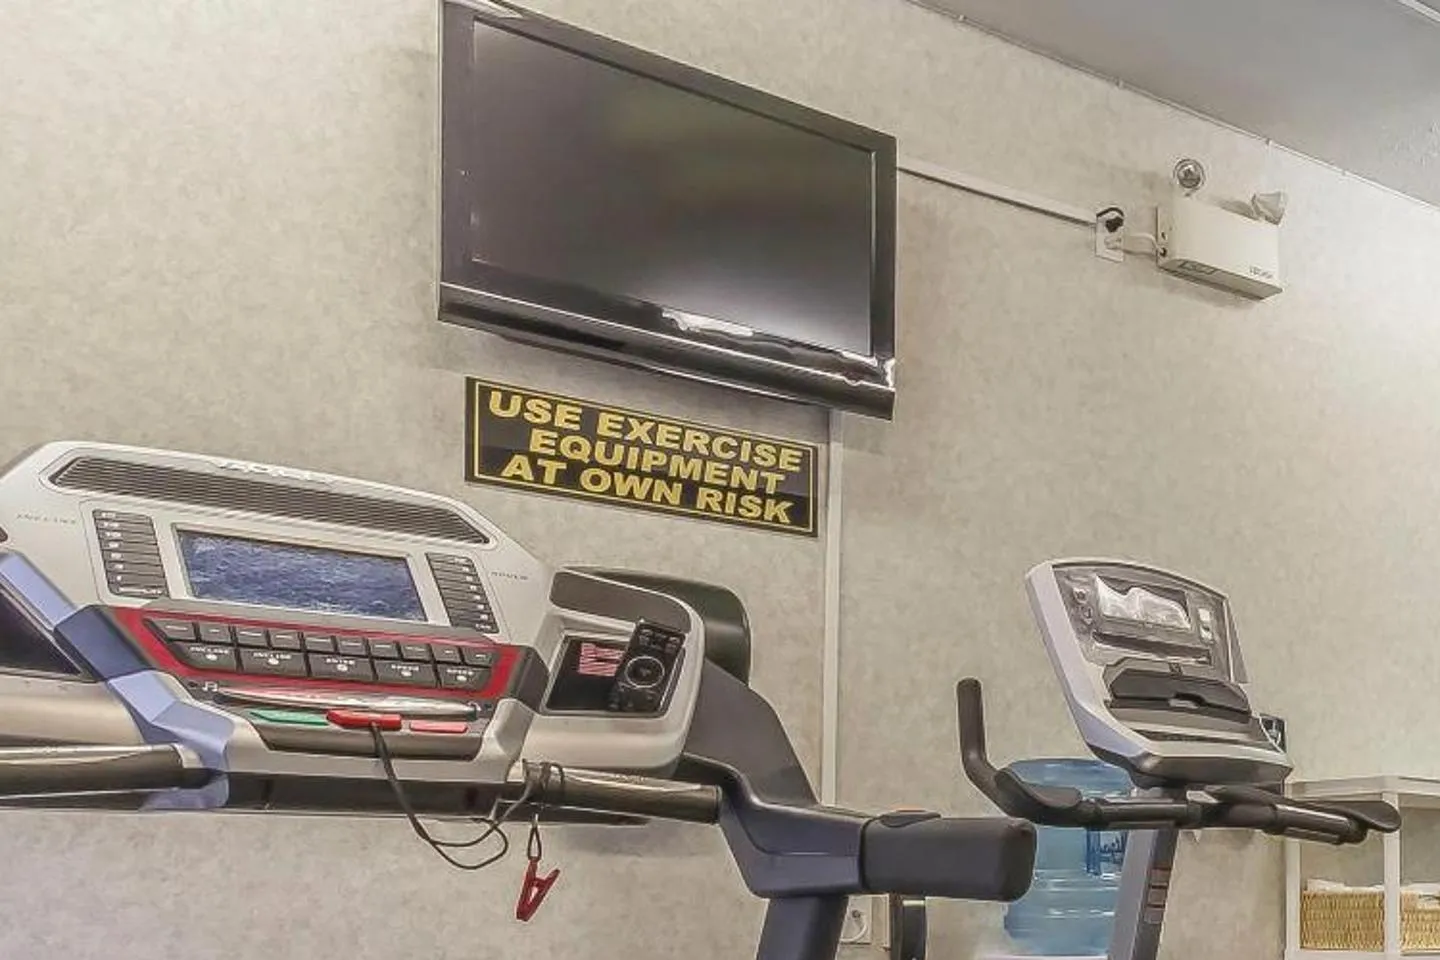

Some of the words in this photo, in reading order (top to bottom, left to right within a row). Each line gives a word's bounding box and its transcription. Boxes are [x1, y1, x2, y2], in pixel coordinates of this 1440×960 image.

[488, 390, 583, 430] USE
[596, 412, 804, 472] EXERCISE
[529, 429, 785, 494] EQUIPMENT
[501, 455, 567, 484] AT
[579, 468, 683, 505] OWN
[695, 489, 795, 524] RISK
